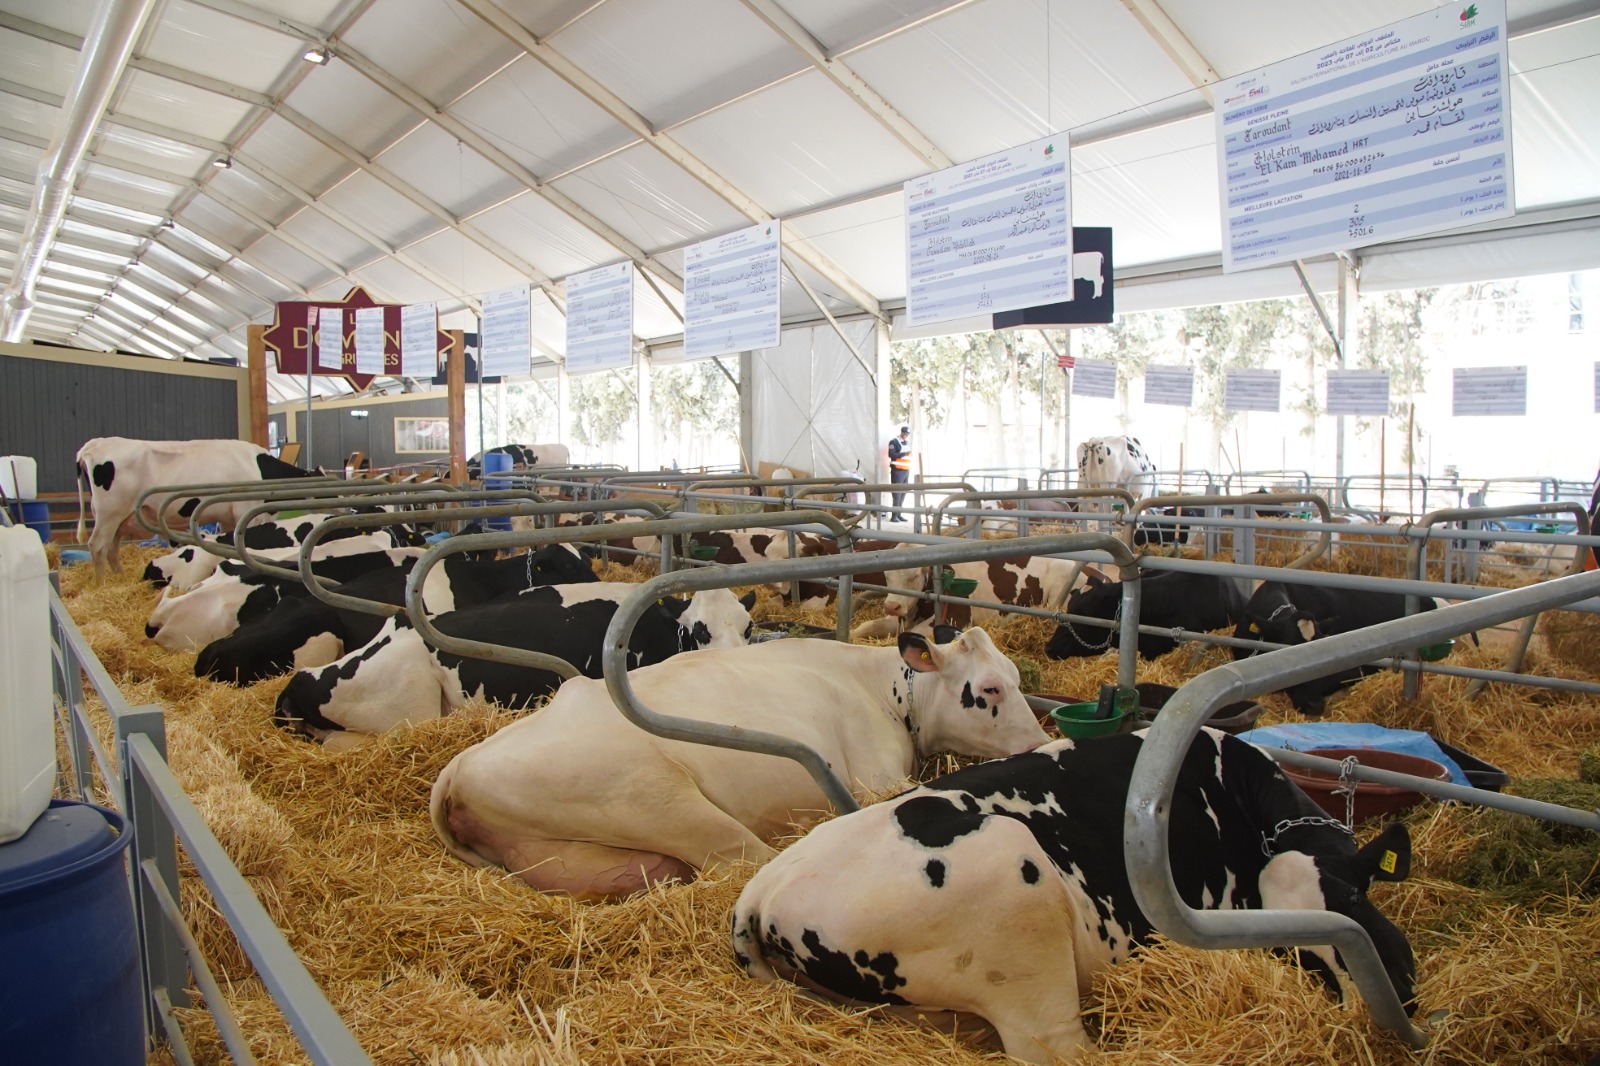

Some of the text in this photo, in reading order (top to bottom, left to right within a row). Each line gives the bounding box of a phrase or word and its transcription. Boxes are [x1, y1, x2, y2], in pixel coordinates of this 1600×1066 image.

[1290, 76, 1307, 86] SALON
[1308, 64, 1347, 80] INTERNATIONAL
[1408, 36, 1430, 47] MAROC
[1316, 60, 1332, 70] 2023
[1270, 109, 1288, 119] PLEINE
[1244, 118, 1292, 142] Taroudant
[1254, 145, 1300, 166] Holstein
[1256, 162, 1272, 176] El
[1273, 159, 1297, 173] Kam
[1300, 142, 1348, 164] Mohamed
[1244, 194, 1302, 212] MEILLEURE LACTATION
[1354, 204, 1359, 214] 2
[1349, 216, 1364, 228] 305
